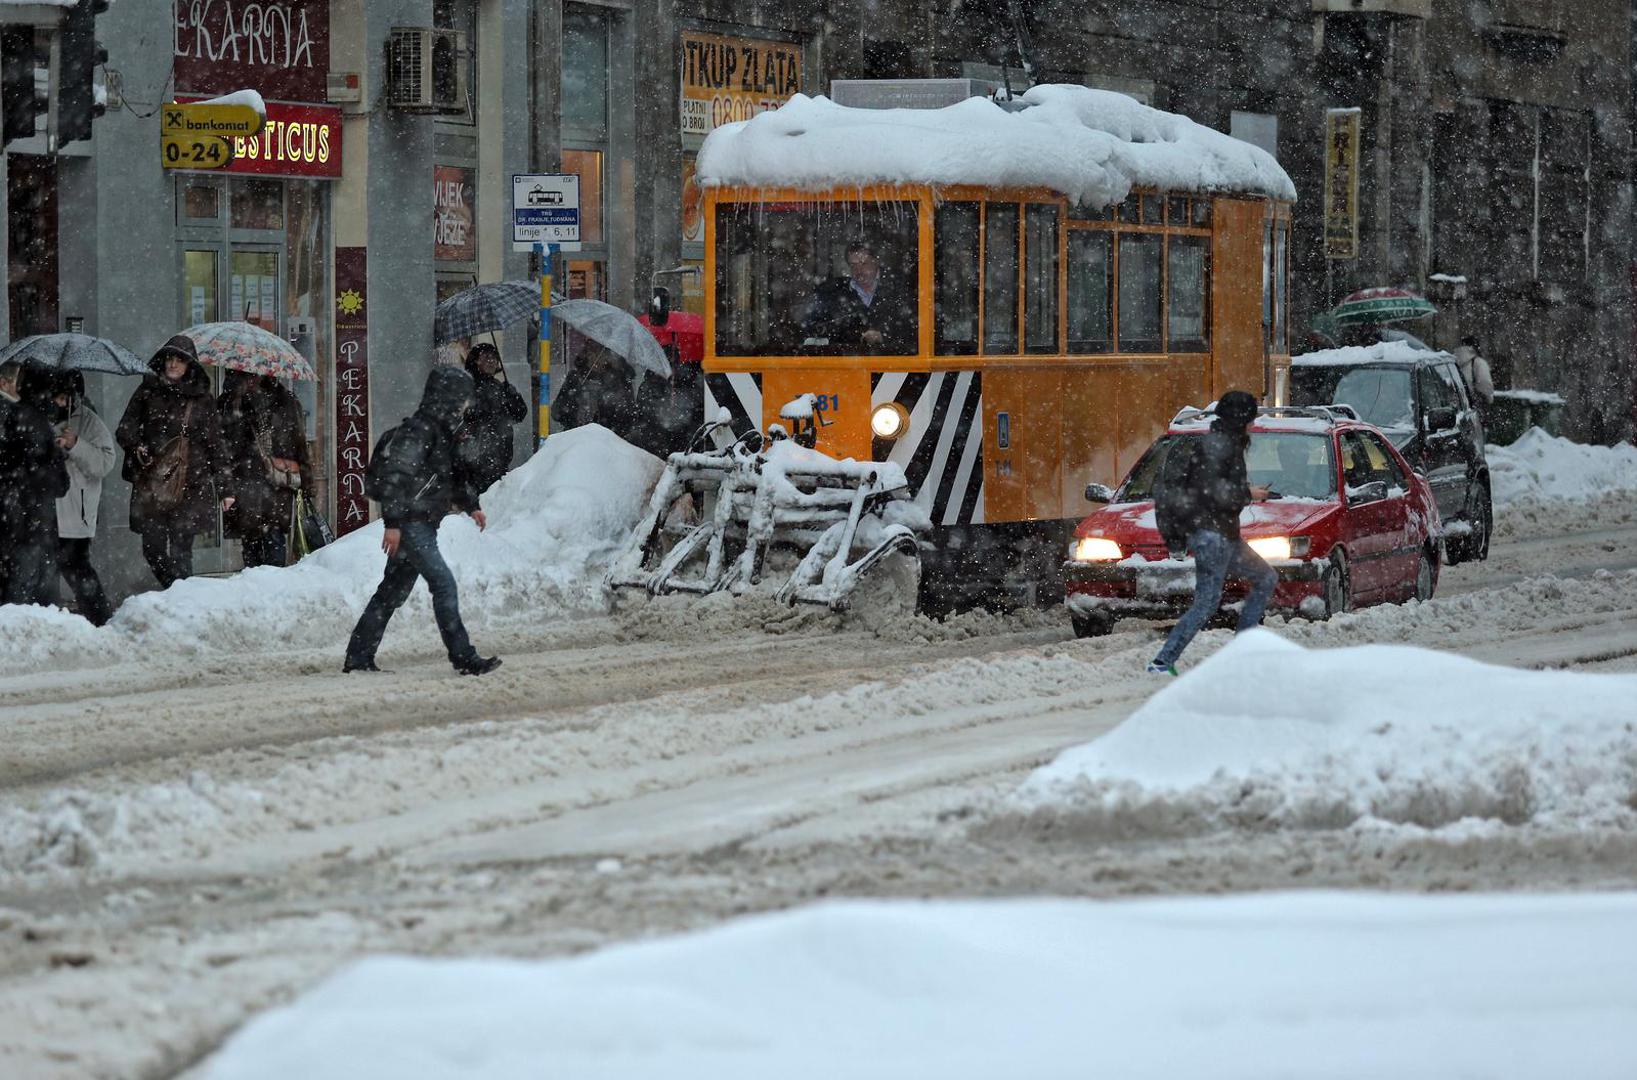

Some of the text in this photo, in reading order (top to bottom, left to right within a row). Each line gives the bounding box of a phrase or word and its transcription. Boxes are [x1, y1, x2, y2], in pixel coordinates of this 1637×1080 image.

[683, 40, 798, 95] TKUP ZLATA
[186, 119, 249, 130] bankomat
[689, 116, 704, 129] BROJ
[713, 96, 753, 128] 0800
[166, 142, 220, 161] 0-24
[222, 120, 329, 163] ESTICUS
[519, 228, 540, 238] linije
[554, 228, 563, 237] 6,
[567, 227, 576, 236] 11
[340, 341, 366, 521] PEKARNA
